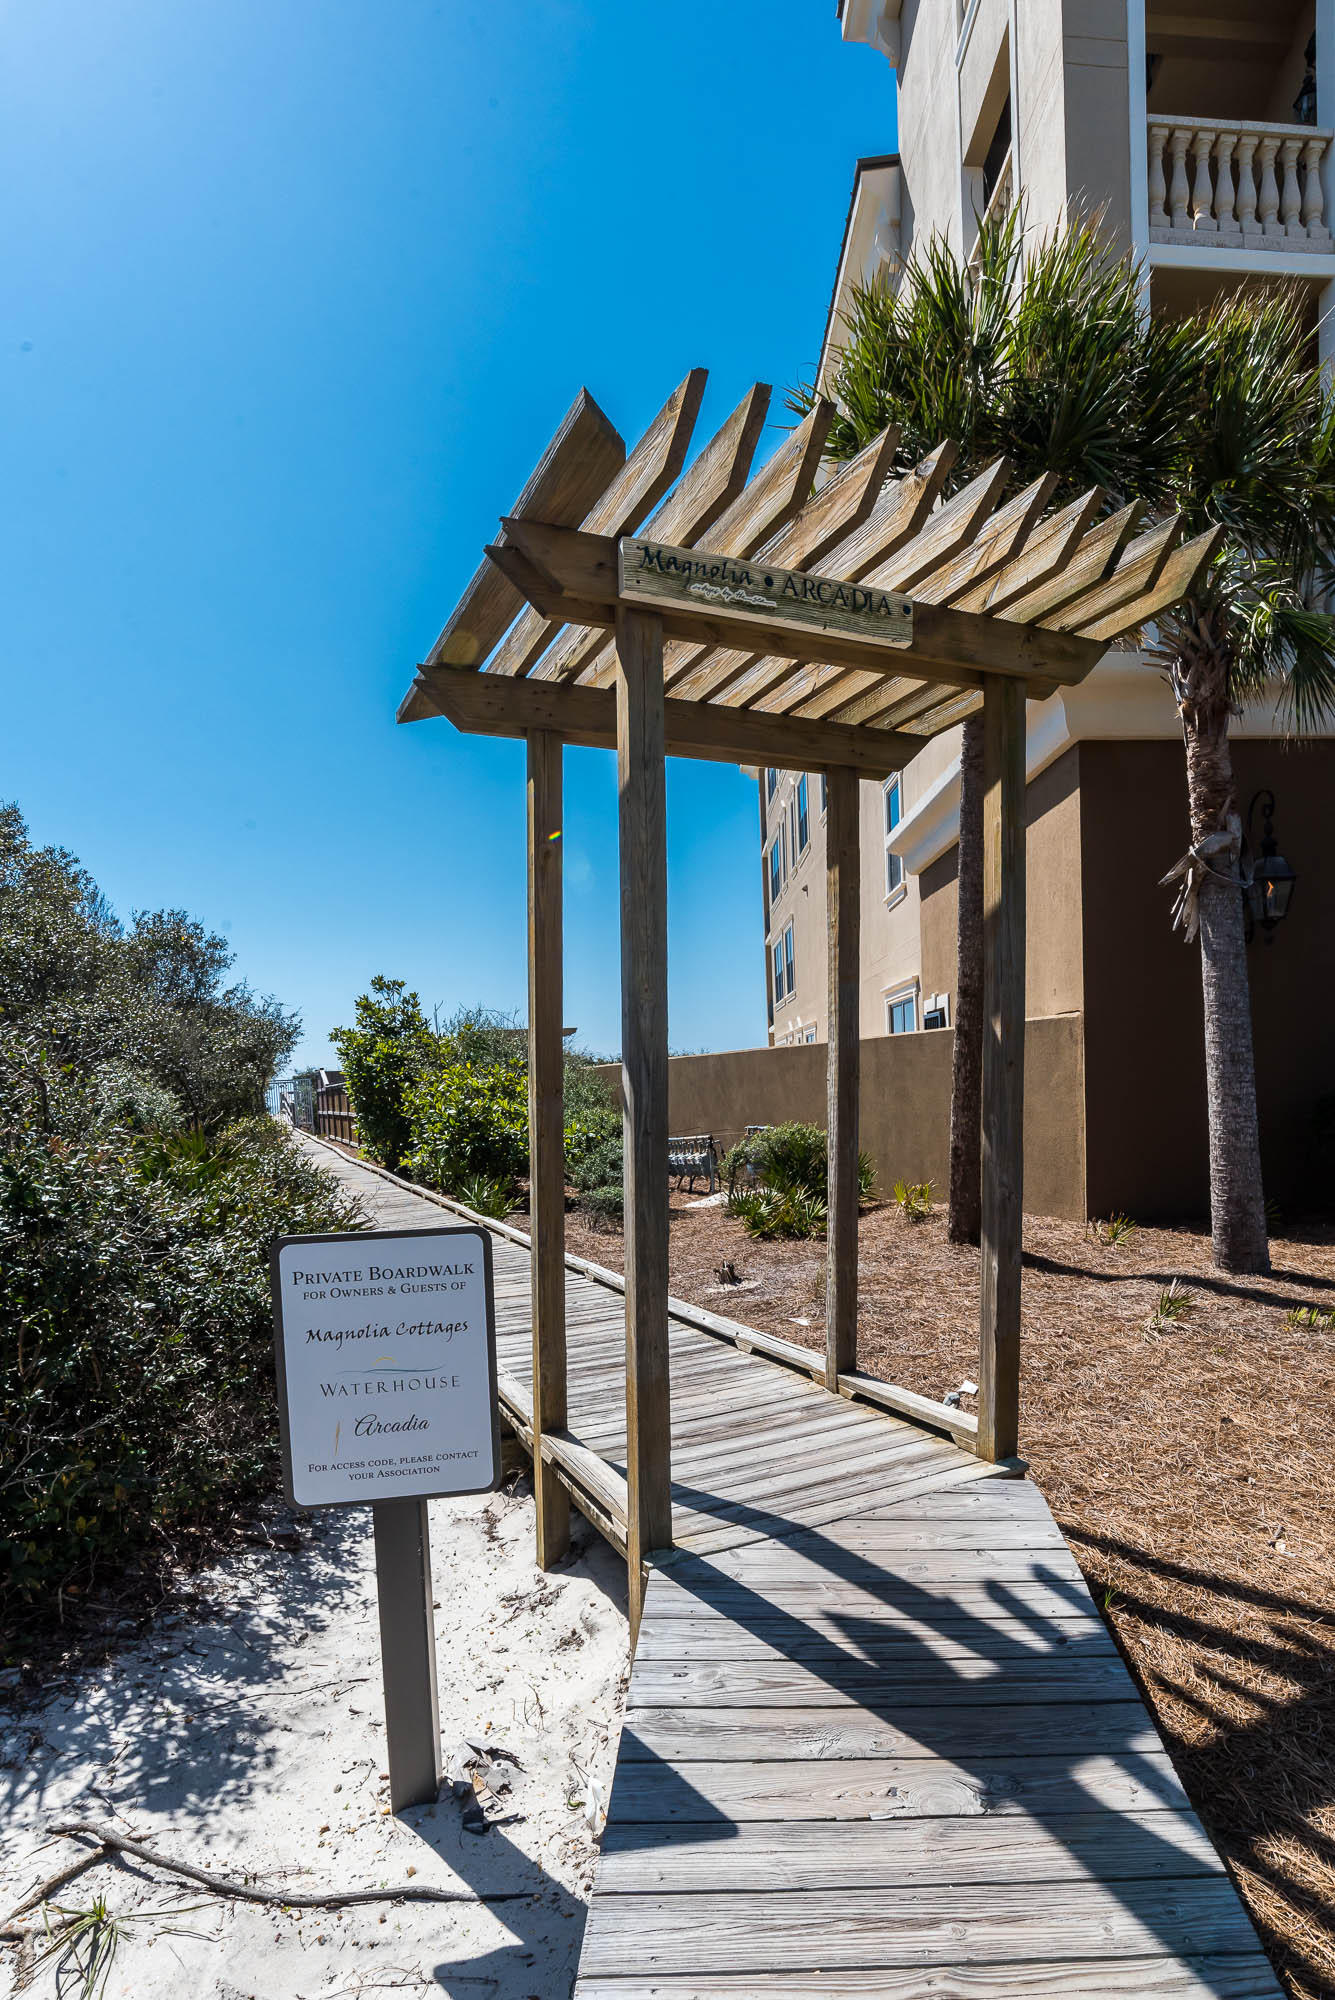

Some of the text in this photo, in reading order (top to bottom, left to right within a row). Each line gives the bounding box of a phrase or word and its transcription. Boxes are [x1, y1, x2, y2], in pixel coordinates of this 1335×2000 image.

[636, 545, 893, 616] Magnolia ARCADIA
[292, 1263, 475, 1286] PRIVATE BOARDWALK
[303, 1281, 467, 1300] FOR OWNERS & GUESTS OF
[305, 1320, 469, 1350] Magnolia Cottages
[319, 1375, 462, 1398] WATERHOUSE
[354, 1413, 431, 1437] Arcadia
[308, 1450, 479, 1473] FOR ACCESS CODE, PLEASE CONTACT
[348, 1465, 441, 1481] YOUR ASSOCIATION
